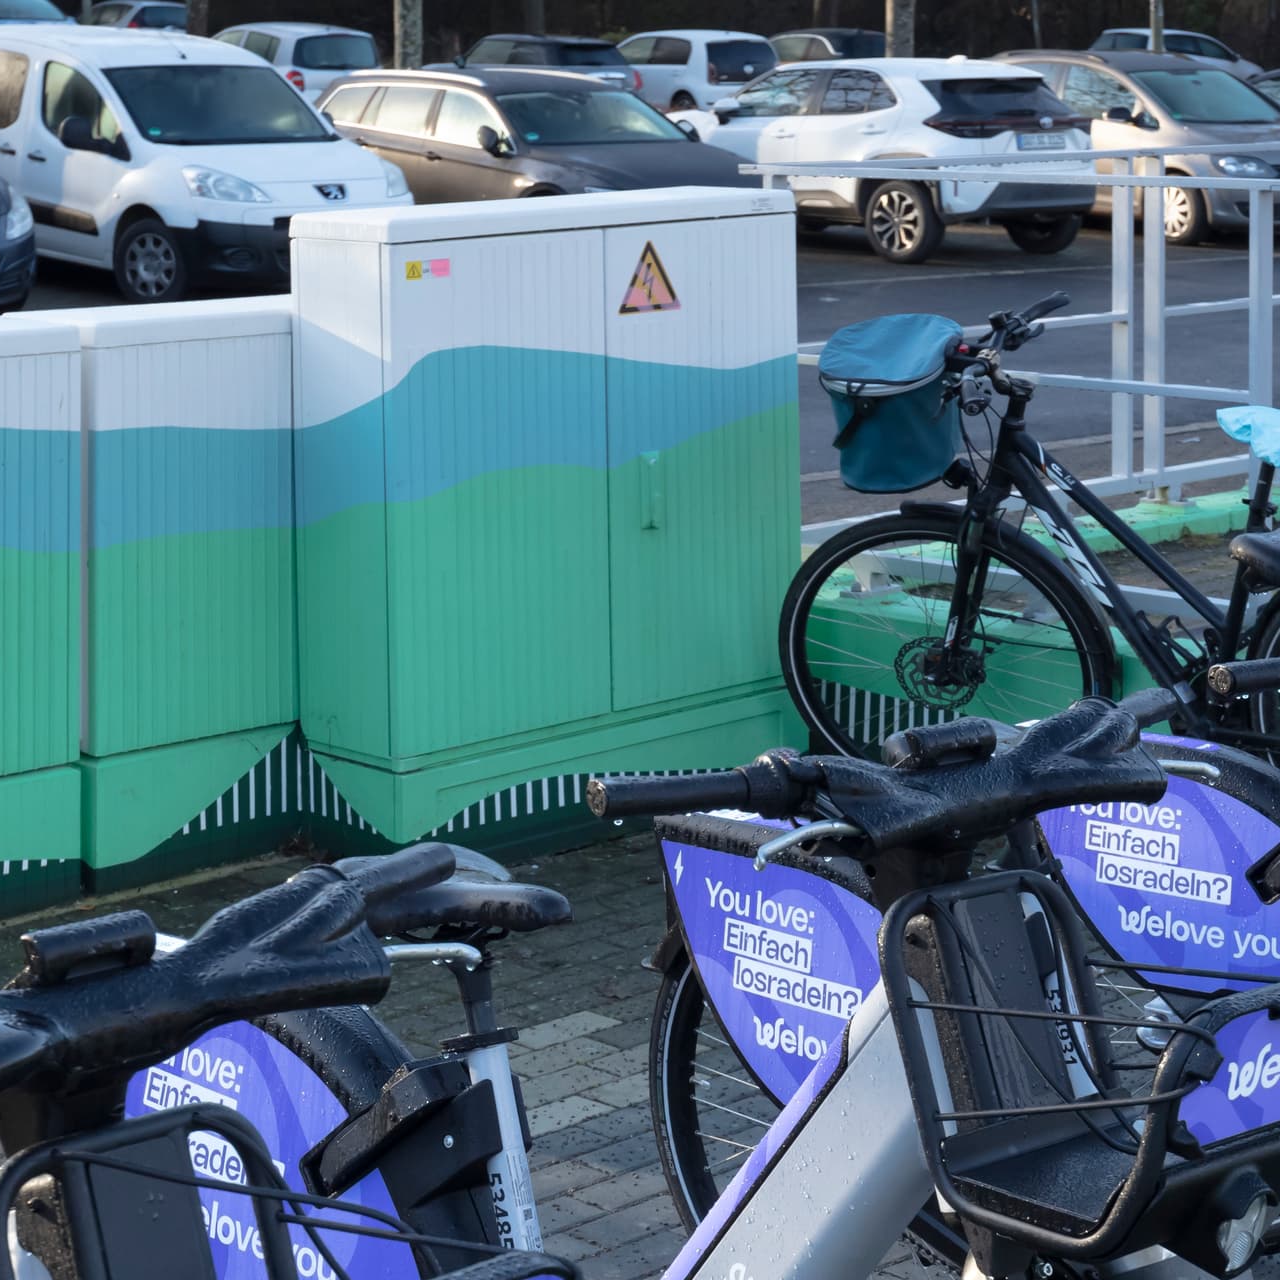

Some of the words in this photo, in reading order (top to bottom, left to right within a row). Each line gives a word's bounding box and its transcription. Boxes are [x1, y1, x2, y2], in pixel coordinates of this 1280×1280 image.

[1120, 801, 1182, 830] love:
[1087, 824, 1177, 861] Einfach
[1099, 856, 1229, 901] losradeln?
[705, 877, 750, 918] You
[756, 890, 816, 935] love:
[1118, 904, 1225, 949] Welove
[726, 921, 809, 970] Einfach
[735, 962, 860, 1017] losradeln?
[1046, 989, 1078, 1065] 53931
[181, 1047, 244, 1093] love:
